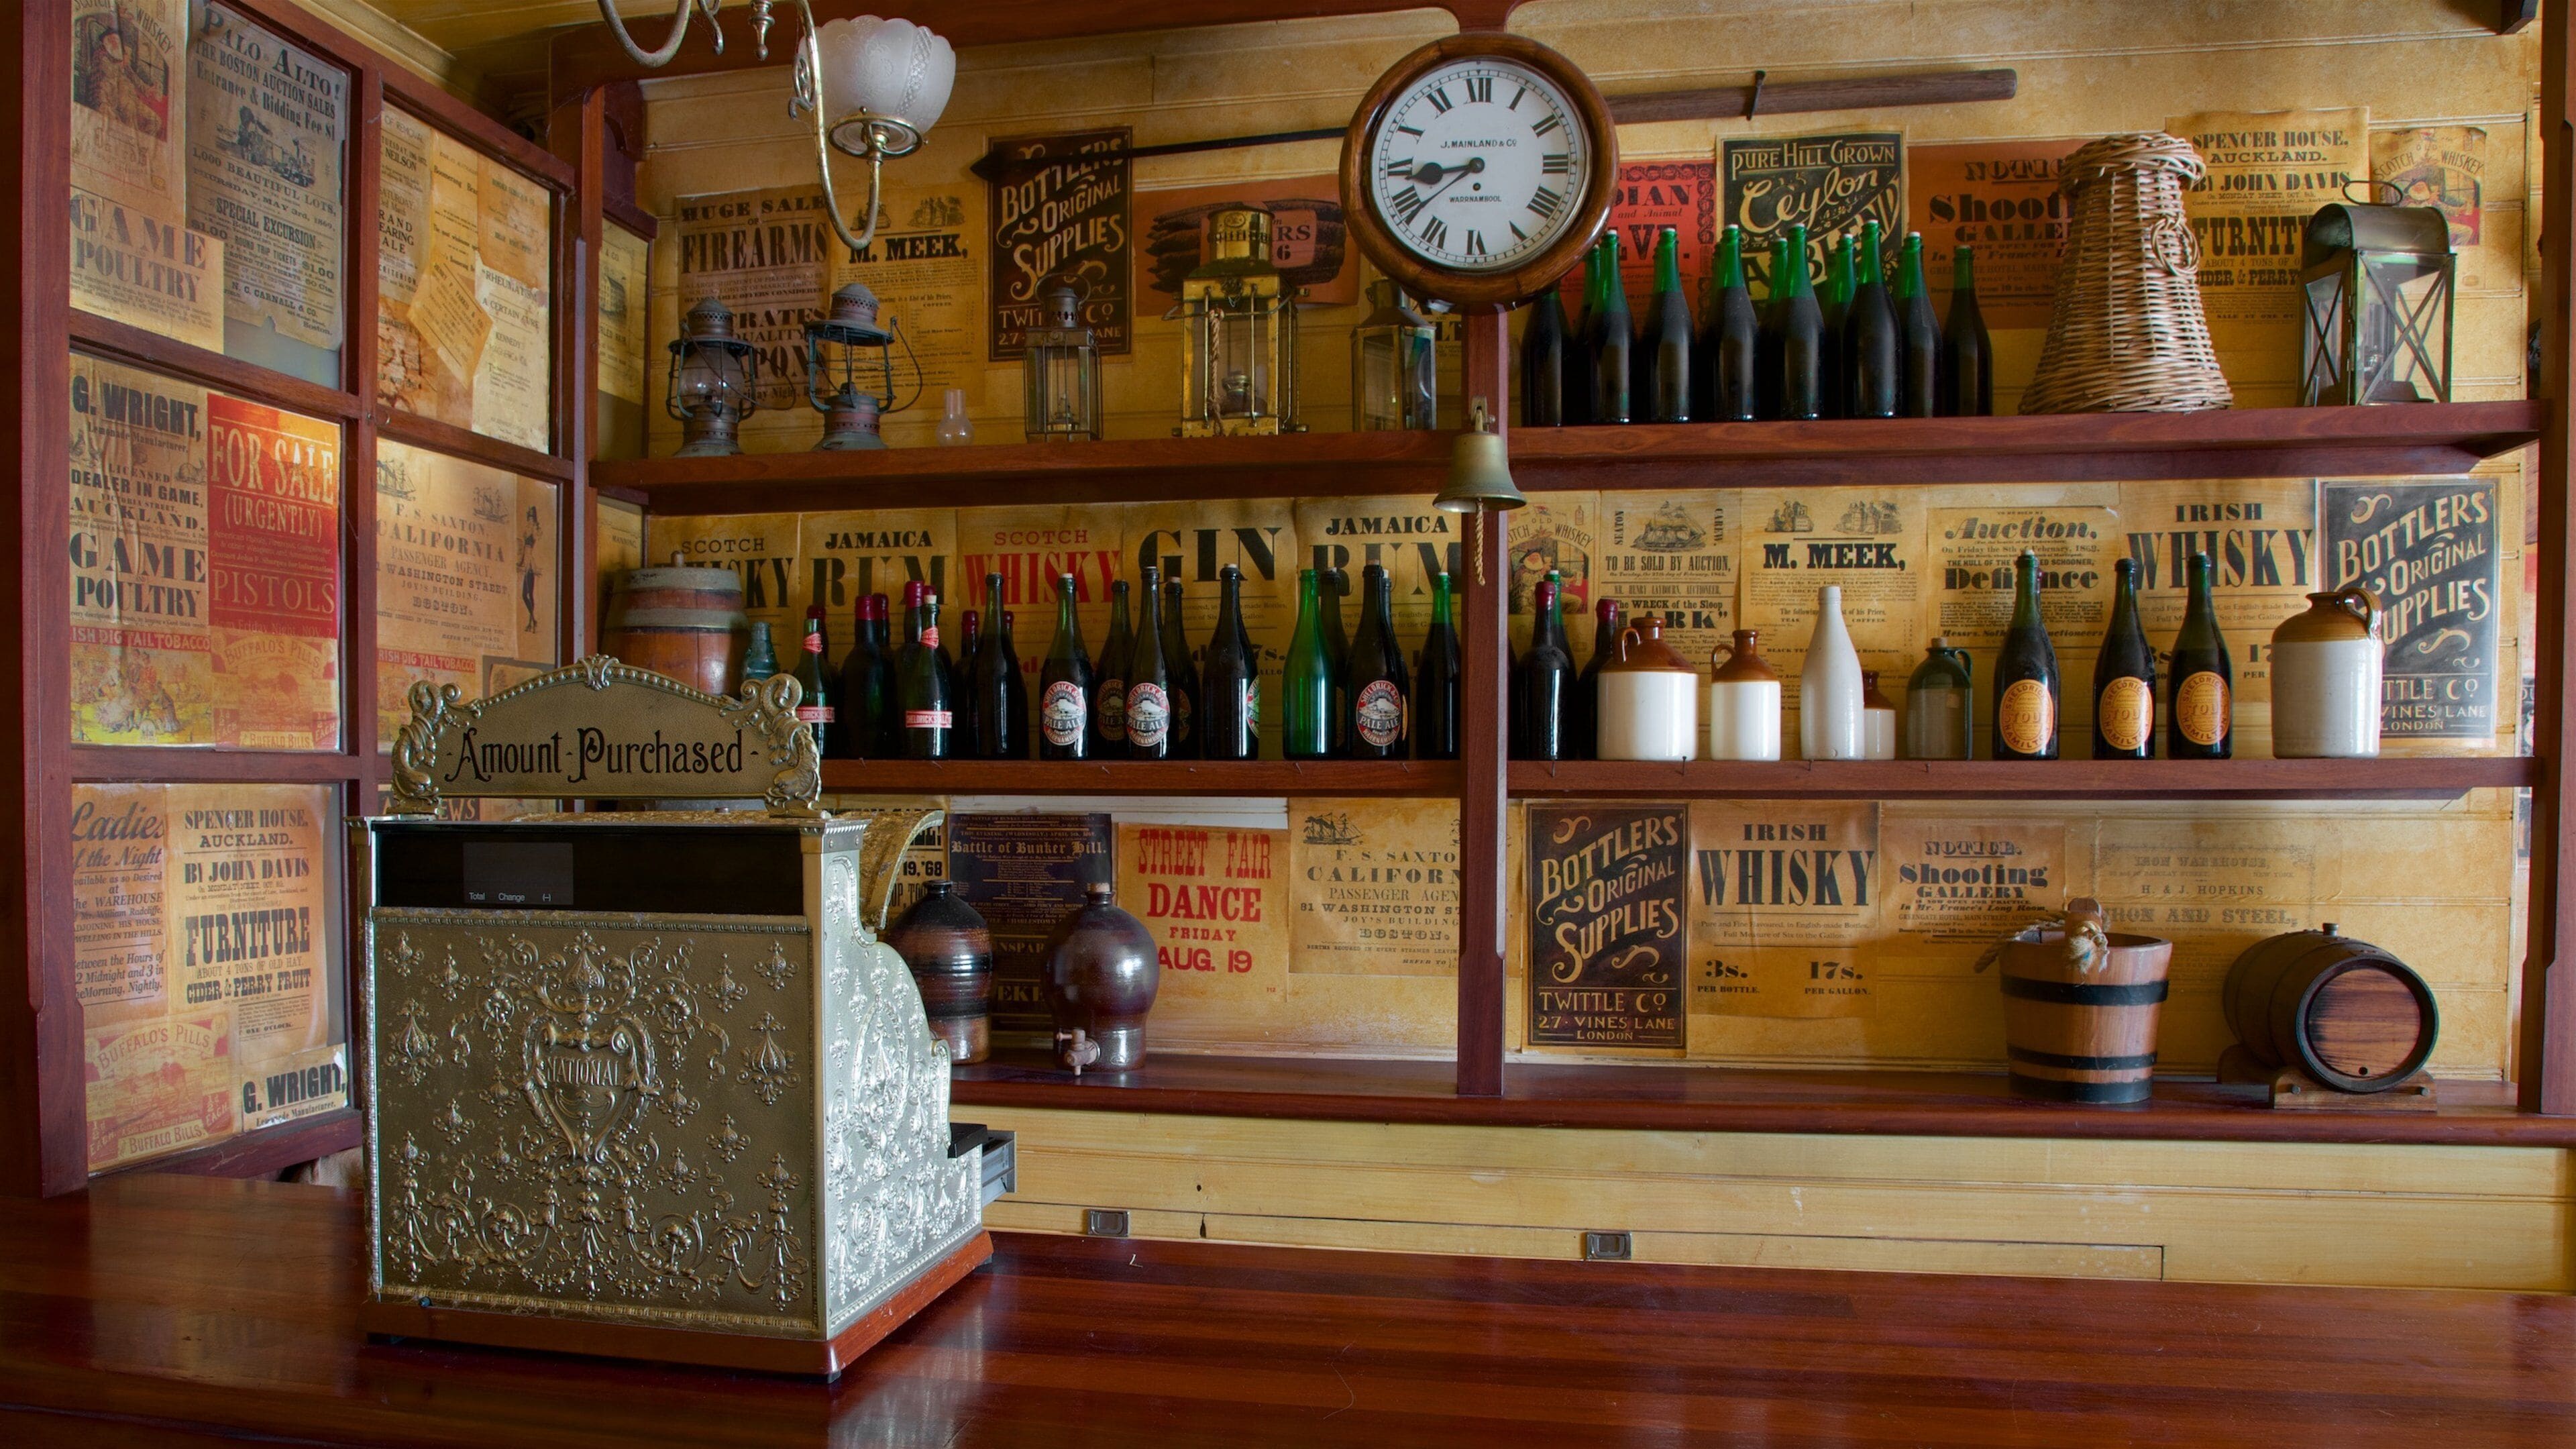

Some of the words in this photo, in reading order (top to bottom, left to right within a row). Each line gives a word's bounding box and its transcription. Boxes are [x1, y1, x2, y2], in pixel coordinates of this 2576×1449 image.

[201, 8, 260, 60] PALO
[273, 49, 340, 100] ALTO!
[196, 39, 216, 62] THE
[219, 49, 260, 83] BOSTON
[263, 72, 304, 105] AUCTION
[307, 94, 335, 119] SALES
[385, 148, 417, 171] NEILSON
[1733, 152, 1779, 180] PURE
[1784, 144, 1825, 167] HILL
[1831, 140, 1894, 166] GROWN
[2210, 152, 2327, 164] AUCKLAND.
[2374, 153, 2415, 179] SCOTCH
[2440, 150, 2483, 173] WHISKEY
[2220, 174, 2277, 191] JOHN
[2286, 172, 2351, 190] DAVIS
[1042, 175, 1121, 233] ORIGINAL
[1740, 167, 1879, 233] Ceylon
[70, 194, 206, 268] GAME
[217, 197, 258, 228] SPECIAL
[264, 215, 315, 250] EXCURSION
[382, 236, 405, 254] ALE
[682, 223, 827, 274] FIREARMS
[1011, 214, 1124, 301] SUPPLIES
[76, 237, 201, 304] POULTRY
[73, 376, 97, 415] G.
[103, 382, 201, 442] WRIGHT,
[211, 425, 263, 490] FOR
[275, 438, 333, 504] SALE
[71, 469, 130, 493] DEALER
[137, 482, 152, 497] IN
[158, 486, 203, 508] GAME,
[71, 497, 204, 531] AUCKLAND.
[225, 493, 321, 543] (URGENTLY)
[2176, 503, 2262, 521] IRISH
[1326, 515, 1448, 535] JAMAICA
[1615, 511, 1623, 545] SEATON
[1945, 516, 2097, 539] Auction.
[682, 538, 765, 554] SCOTCH
[824, 531, 932, 550] JAMAICA
[994, 530, 1087, 545] SCOTCH
[70, 533, 205, 583] GAME
[1138, 528, 1282, 584] GIN
[1606, 556, 1617, 570] TO
[1624, 556, 1635, 570] BE
[1641, 556, 1664, 570] SOLD
[1670, 556, 1682, 570] BY
[1689, 556, 1731, 572] AUCTION,
[1764, 544, 1796, 570] M.
[1807, 543, 1905, 570] MEEK,
[2127, 529, 2313, 590] WHISKY
[2390, 533, 2486, 596] ORIGINAL
[76, 576, 200, 618] POULTRY
[212, 570, 335, 614] PISTOLS
[1631, 600, 1669, 608] WRECK
[1672, 600, 1680, 608] of
[1700, 600, 1723, 610] Sloop
[127, 631, 154, 647] TAIL
[157, 633, 211, 651] TOBACCO
[1044, 718, 1063, 729] PALE
[1066, 718, 1083, 729] ALE
[1127, 719, 1146, 730] PALE
[1149, 719, 1166, 731] ALE
[1359, 716, 1381, 729] PALE
[1385, 716, 1399, 729] ALE
[72, 802, 164, 841] Ladies
[1743, 824, 1827, 841] IRISH
[200, 833, 293, 848] AUCKLAND.
[951, 840, 993, 854] Battle
[999, 839, 1012, 853] of
[1016, 841, 1065, 855] Bunker
[1071, 839, 1106, 856] Hill.
[1925, 841, 2022, 855] NOTICE.
[87, 848, 111, 867] the
[115, 845, 162, 869] Night
[1138, 828, 1207, 875] STREET
[1227, 831, 1271, 879] FAIR
[1539, 814, 1684, 910] BOTTLERS'
[2135, 857, 2170, 867] IRON
[209, 860, 255, 882] JOHN
[262, 857, 310, 879] DAVIS
[1697, 849, 1874, 906] WHISKY
[1900, 863, 2048, 888] Shooting
[109, 884, 119, 894] at
[1330, 888, 1409, 902] PASSENGER
[1589, 856, 1675, 912] ORIGINAL
[1917, 886, 2025, 898] GALLERY
[95, 892, 162, 907] WAREHOUSE
[469, 892, 486, 902] Total
[498, 892, 525, 903] Change
[1147, 883, 1261, 922] DANCE
[1300, 903, 1314, 912] 81
[1321, 903, 1437, 914] WASHINGTON
[2165, 908, 2211, 922] AND
[141, 929, 163, 937] HILLS.
[185, 907, 311, 967] FURNITURE
[1170, 927, 1236, 941] FRIDAY
[1552, 898, 1678, 983] SUPPLIES
[111, 955, 124, 966] the
[127, 953, 153, 964] Hours
[156, 949, 165, 963] of
[1157, 947, 1216, 971] AUG.
[1228, 951, 1252, 973] 19
[1706, 959, 1748, 978] 3s.
[85, 969, 125, 983] Midnight
[128, 967, 144, 978] and
[146, 965, 153, 976] 3
[156, 965, 164, 975] in
[1810, 961, 1864, 980] 17s.
[187, 979, 222, 1004] CIDER
[225, 979, 231, 996] &
[234, 974, 272, 996] PERRY
[278, 969, 311, 991] FRUIT
[1720, 985, 1760, 994] BOTTLE.
[1575, 1016, 1627, 1029] VINES
[1634, 1018, 1674, 1029] LANE
[1576, 1030, 1633, 1040] LONDON
